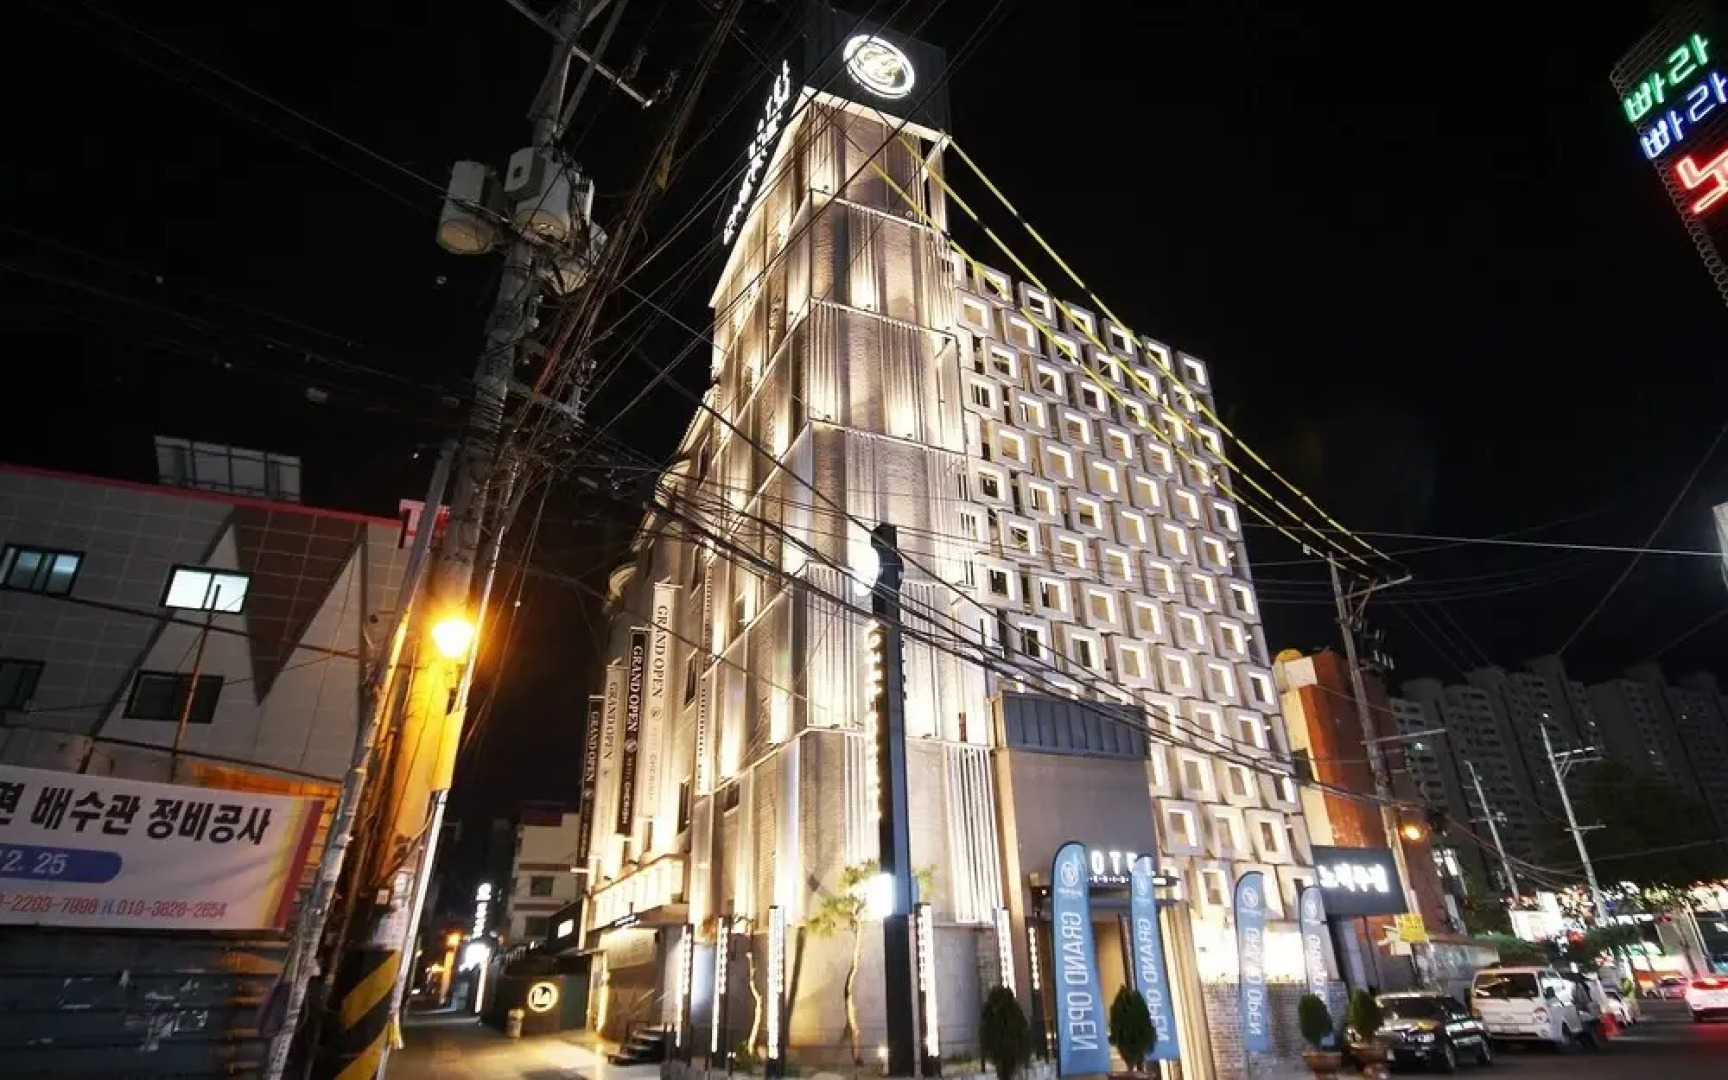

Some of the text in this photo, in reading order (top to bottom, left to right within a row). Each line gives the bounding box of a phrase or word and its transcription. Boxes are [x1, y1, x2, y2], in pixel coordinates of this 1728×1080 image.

[1624, 34, 1709, 121] 빠라
[1640, 72, 1728, 159] 빠라
[627, 645, 643, 732] GRAND OPEN
[651, 605, 669, 699] GRAND OPEN
[588, 711, 600, 749] GRAND
[603, 681, 619, 760] GRAND OPEN
[585, 751, 598, 782] OPEN
[30, 786, 140, 835] 배수관
[147, 797, 271, 845] 정비공사
[32, 851, 69, 875] 25
